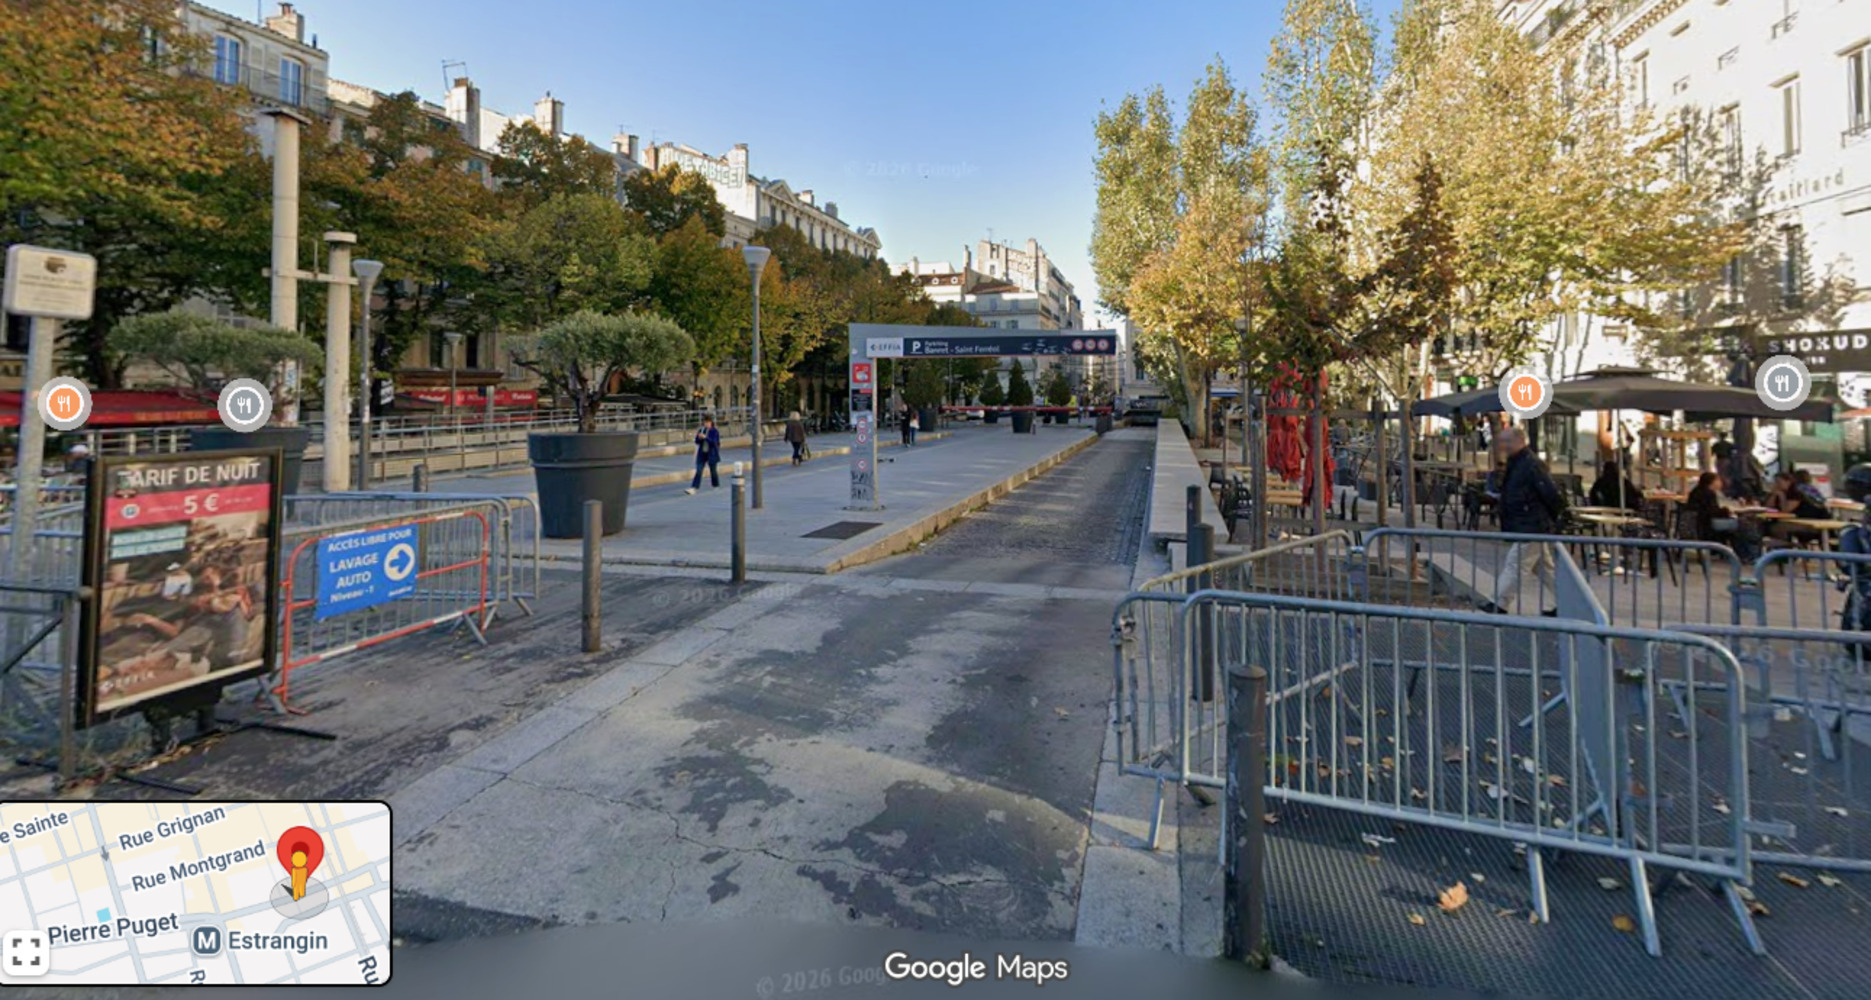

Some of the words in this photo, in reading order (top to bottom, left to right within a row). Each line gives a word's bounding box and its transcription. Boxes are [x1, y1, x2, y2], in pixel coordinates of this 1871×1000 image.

[185, 466, 211, 484] DE
[216, 463, 261, 481] NUIT
[184, 495, 198, 514] 5
[204, 493, 220, 511] €
[361, 532, 387, 546] LIBRE
[388, 528, 412, 540] POUR
[329, 552, 379, 573] LAVAGE
[336, 570, 371, 589] AUTO
[330, 589, 364, 603] Niveau
